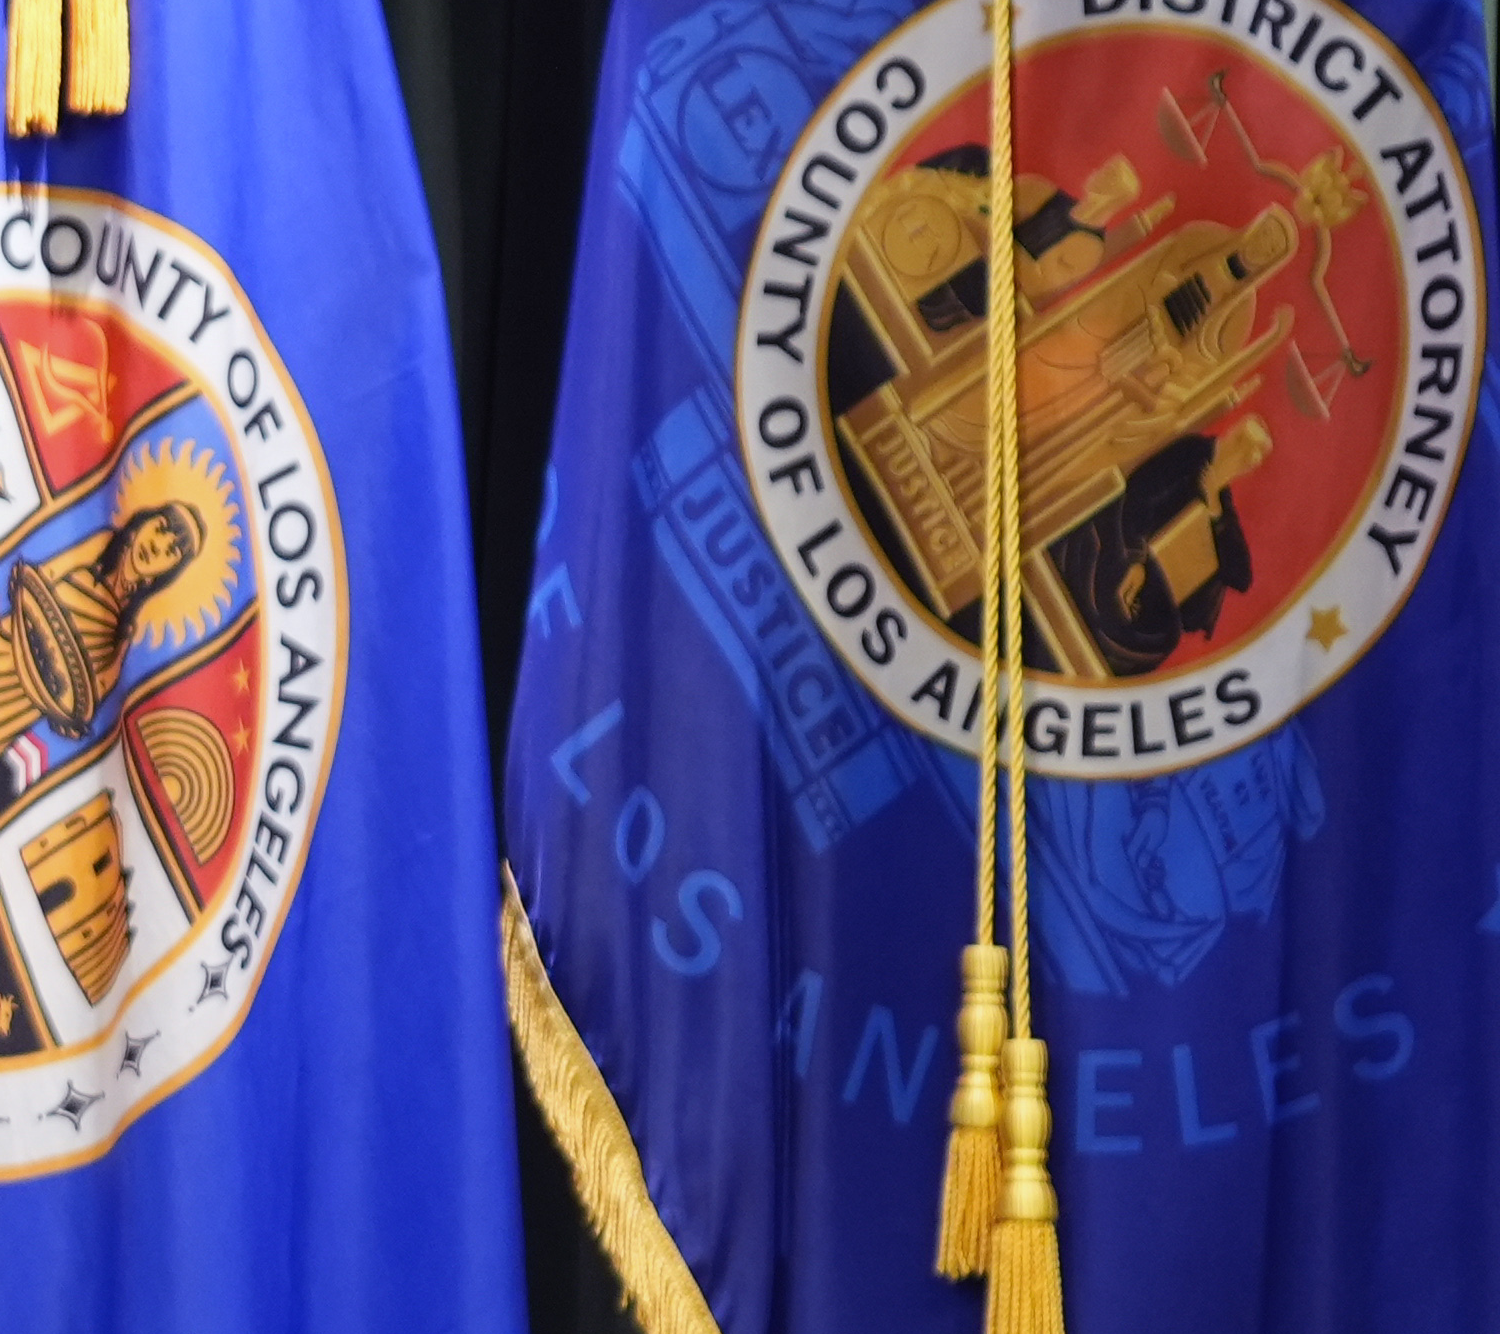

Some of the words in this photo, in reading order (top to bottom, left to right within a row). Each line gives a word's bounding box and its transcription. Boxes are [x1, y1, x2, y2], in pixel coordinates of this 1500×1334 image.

[0, 212, 231, 344] COUNTY
[757, 55, 927, 365] COUNTY
[226, 349, 285, 443] OF
[757, 395, 825, 500] OF
[1367, 138, 1466, 578] ATTORNEY
[257, 460, 325, 611] LOS
[678, 482, 851, 762] JUSTICE
[797, 519, 909, 667] LOS
[220, 632, 327, 973] ANGELES
[549, 697, 744, 977] LOS
[774, 970, 1416, 1155] ANELES
